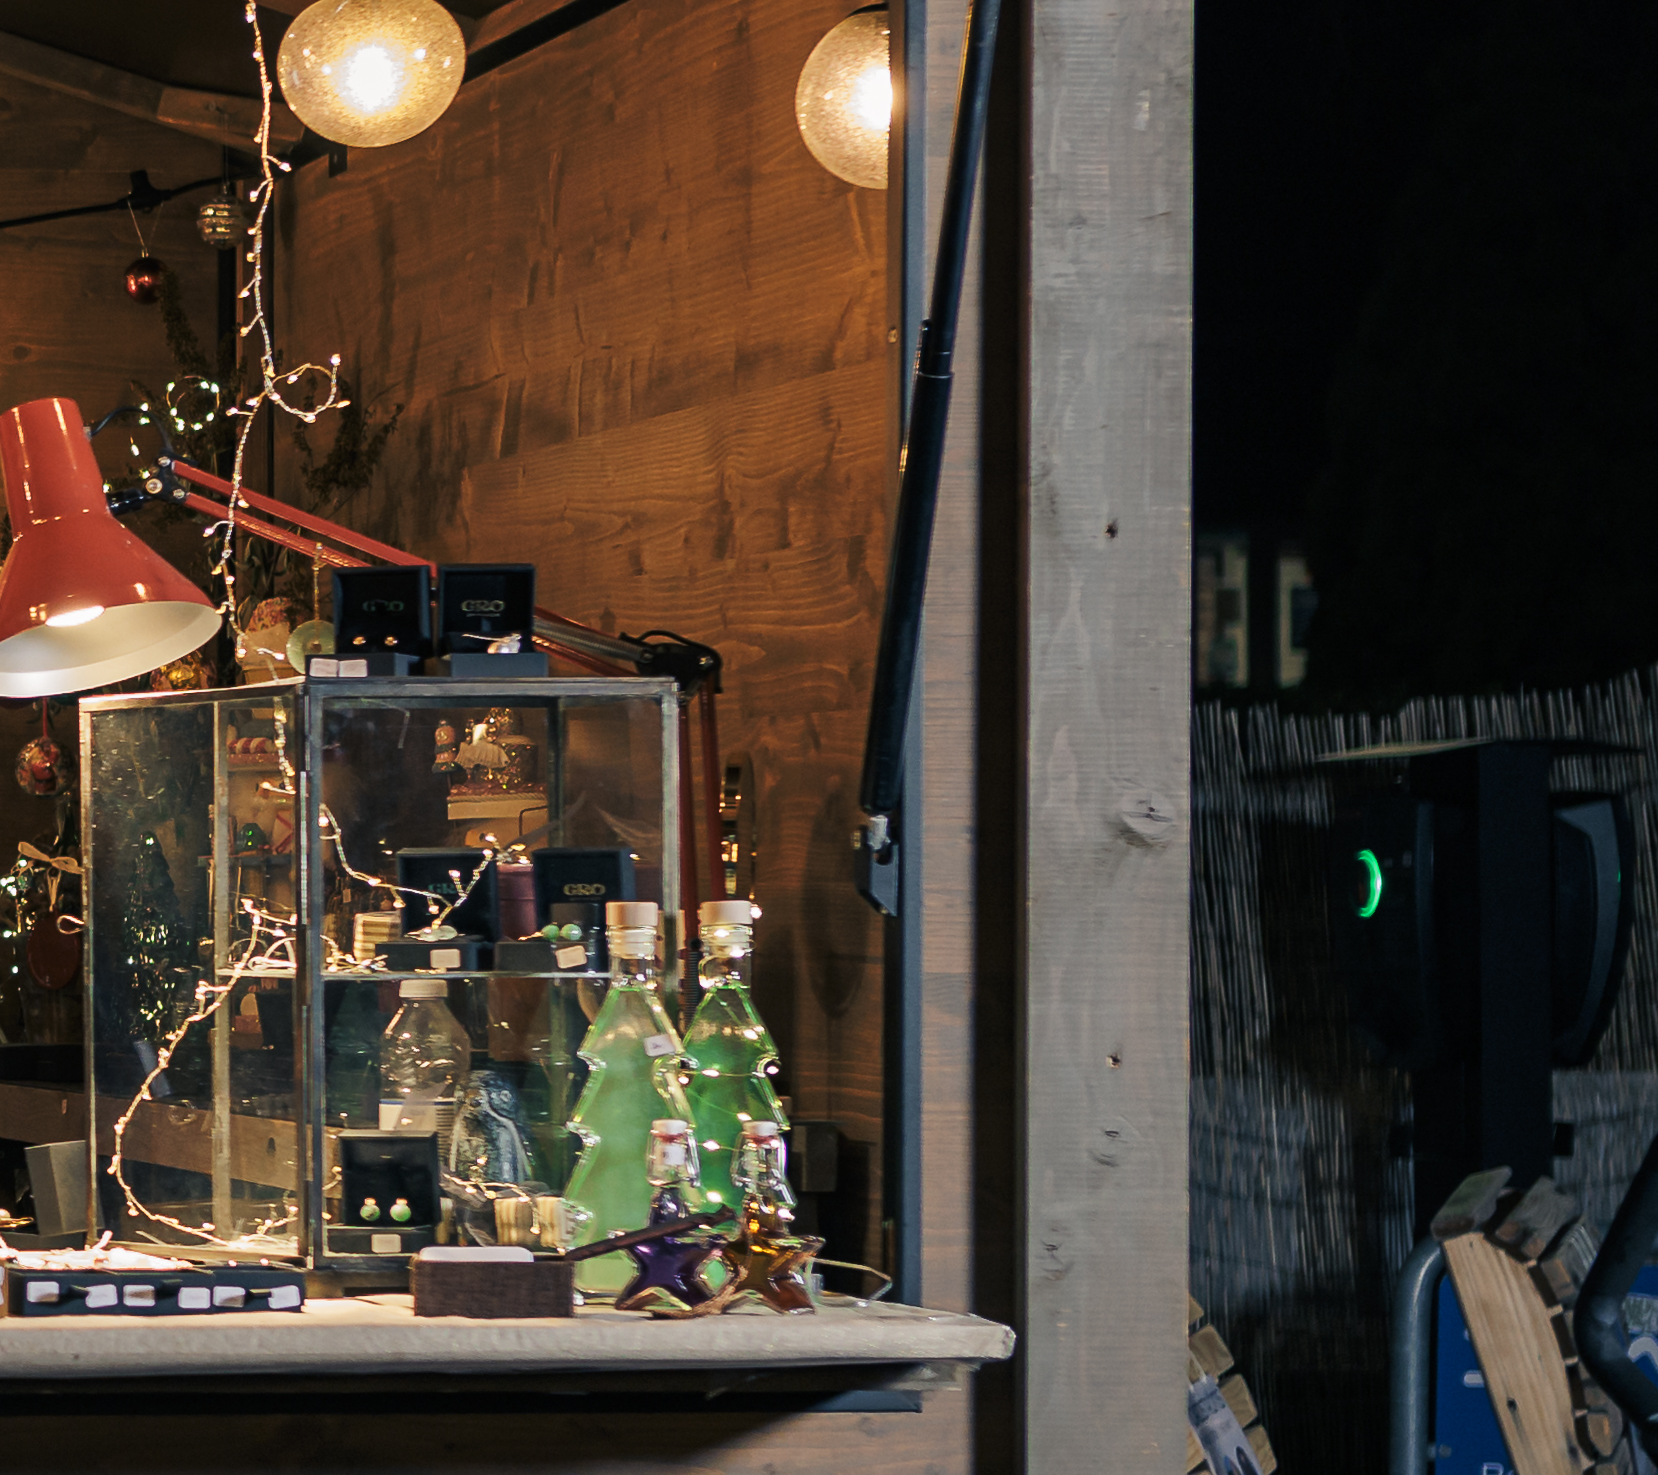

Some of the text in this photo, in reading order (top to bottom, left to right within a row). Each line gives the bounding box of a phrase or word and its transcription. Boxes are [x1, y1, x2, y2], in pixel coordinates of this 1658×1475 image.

[461, 599, 506, 612] GRO
[427, 882, 459, 895] GR
[562, 883, 606, 897] GRO
